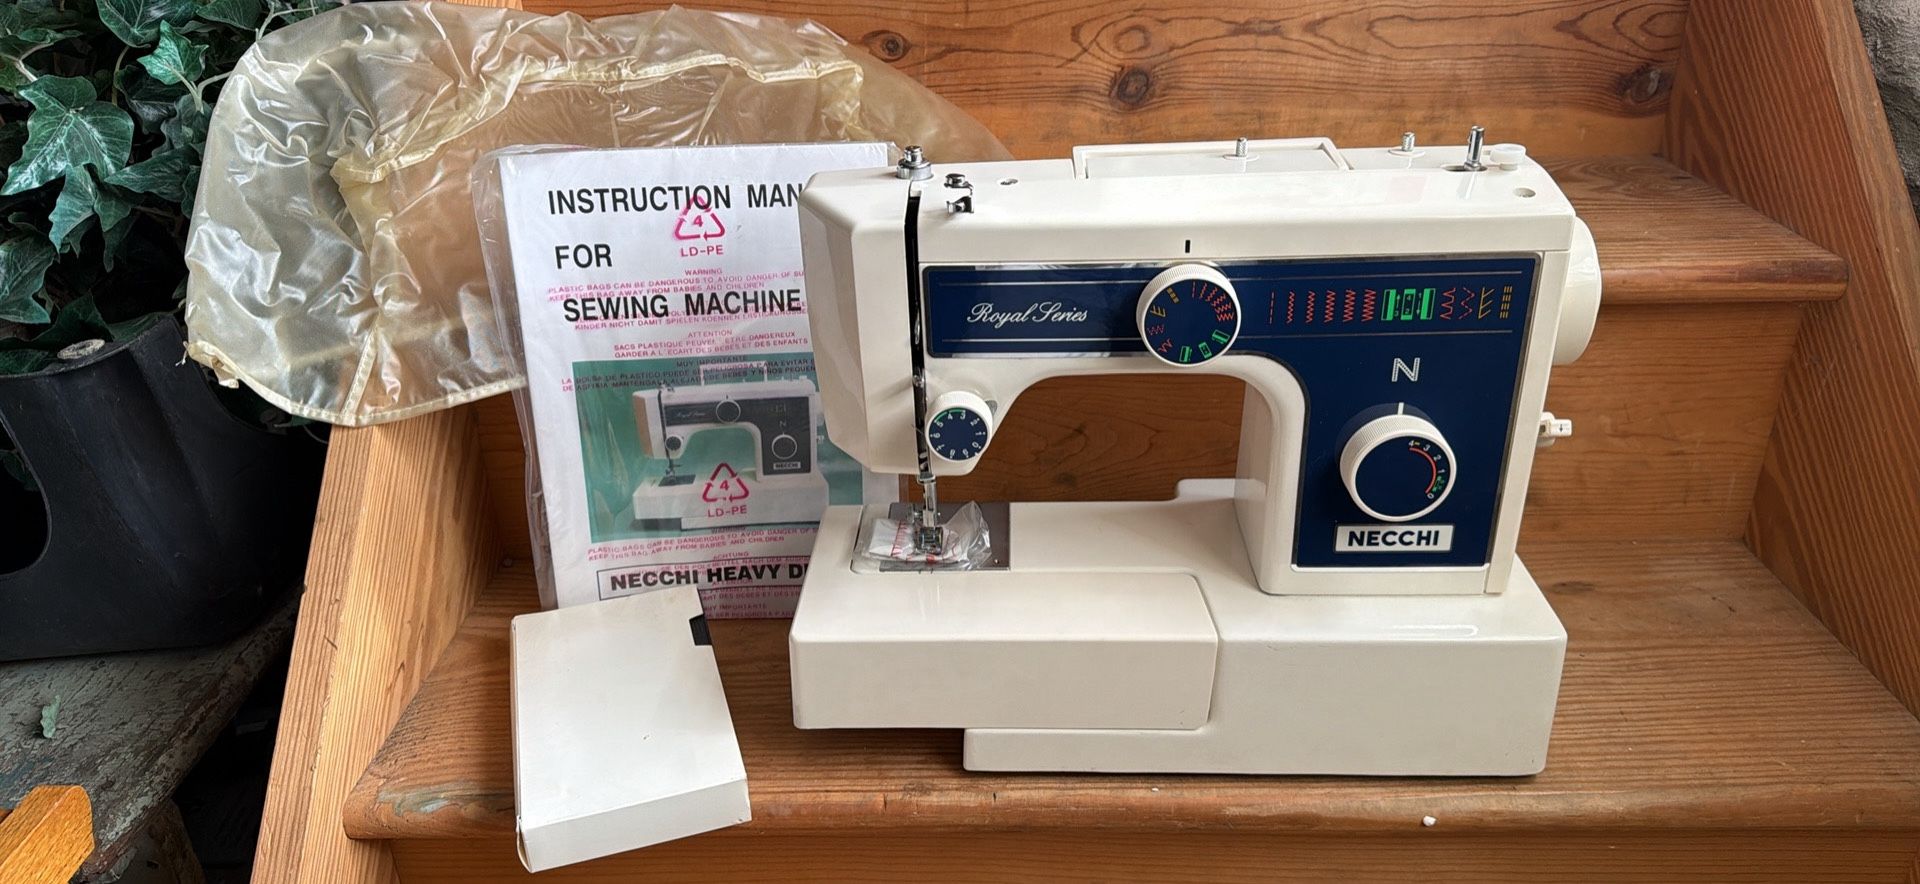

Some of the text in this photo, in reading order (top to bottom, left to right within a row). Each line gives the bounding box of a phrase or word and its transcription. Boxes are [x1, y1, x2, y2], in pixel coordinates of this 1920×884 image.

[548, 184, 731, 215] INSTRUCTION
[693, 215, 703, 227] 4
[555, 243, 612, 270] FOR
[680, 244, 724, 257] LD-PE
[685, 268, 722, 276] WARNING
[548, 284, 585, 294] PLASTIC
[587, 283, 611, 291] BAGS
[634, 280, 645, 288] BE
[649, 277, 700, 287] DANGEROUS
[703, 276, 713, 284] TO
[718, 275, 742, 283] AVOID
[746, 272, 778, 281] DANGER
[549, 294, 572, 302] KEEP
[618, 289, 643, 297] AWAY
[646, 287, 671, 295] FROM
[673, 285, 702, 293] BABIES
[726, 282, 765, 291] CHILDREN
[563, 295, 669, 322] SEWING
[685, 289, 801, 316] MACHINE
[967, 301, 1088, 329] Royal Series
[575, 323, 607, 331] KINDER
[609, 321, 634, 329] NICHT
[638, 319, 662, 327] DAMIT
[666, 317, 699, 325] SPIELEN
[702, 314, 740, 323] KOENNEN
[638, 341, 683, 350] PLASTIQUE
[749, 331, 795, 341] DANGEREUX
[688, 329, 732, 338] ATTENTION
[615, 351, 648, 359] GARDER
[715, 344, 740, 353] BEBES
[754, 340, 771, 348] DES
[773, 337, 808, 347] ENFANTS
[621, 371, 660, 380] PLASTICO
[663, 369, 688, 378] PUEDE
[710, 362, 754, 373] PELIGROSA
[781, 358, 808, 367] EVITAR
[697, 355, 748, 366] IMPORTANTE
[1391, 357, 1421, 383] N
[1408, 440, 1415, 448] 4
[1422, 444, 1431, 452] 3
[720, 480, 729, 491] 4
[708, 504, 748, 517] LD-PE
[588, 547, 619, 555] PLASTIC
[677, 535, 724, 544] DANGEROUS
[741, 530, 764, 539] AVOID
[767, 528, 797, 536] DANGER
[1347, 530, 1440, 547] NECCHI
[588, 554, 608, 562] KEEP
[651, 547, 673, 555] AWAY
[699, 542, 726, 550] BABIES
[748, 536, 785, 545] CHILDREN
[713, 551, 749, 560] ACHTUNG
[611, 569, 699, 591] NECCHI
[707, 563, 782, 583] HEAVY
